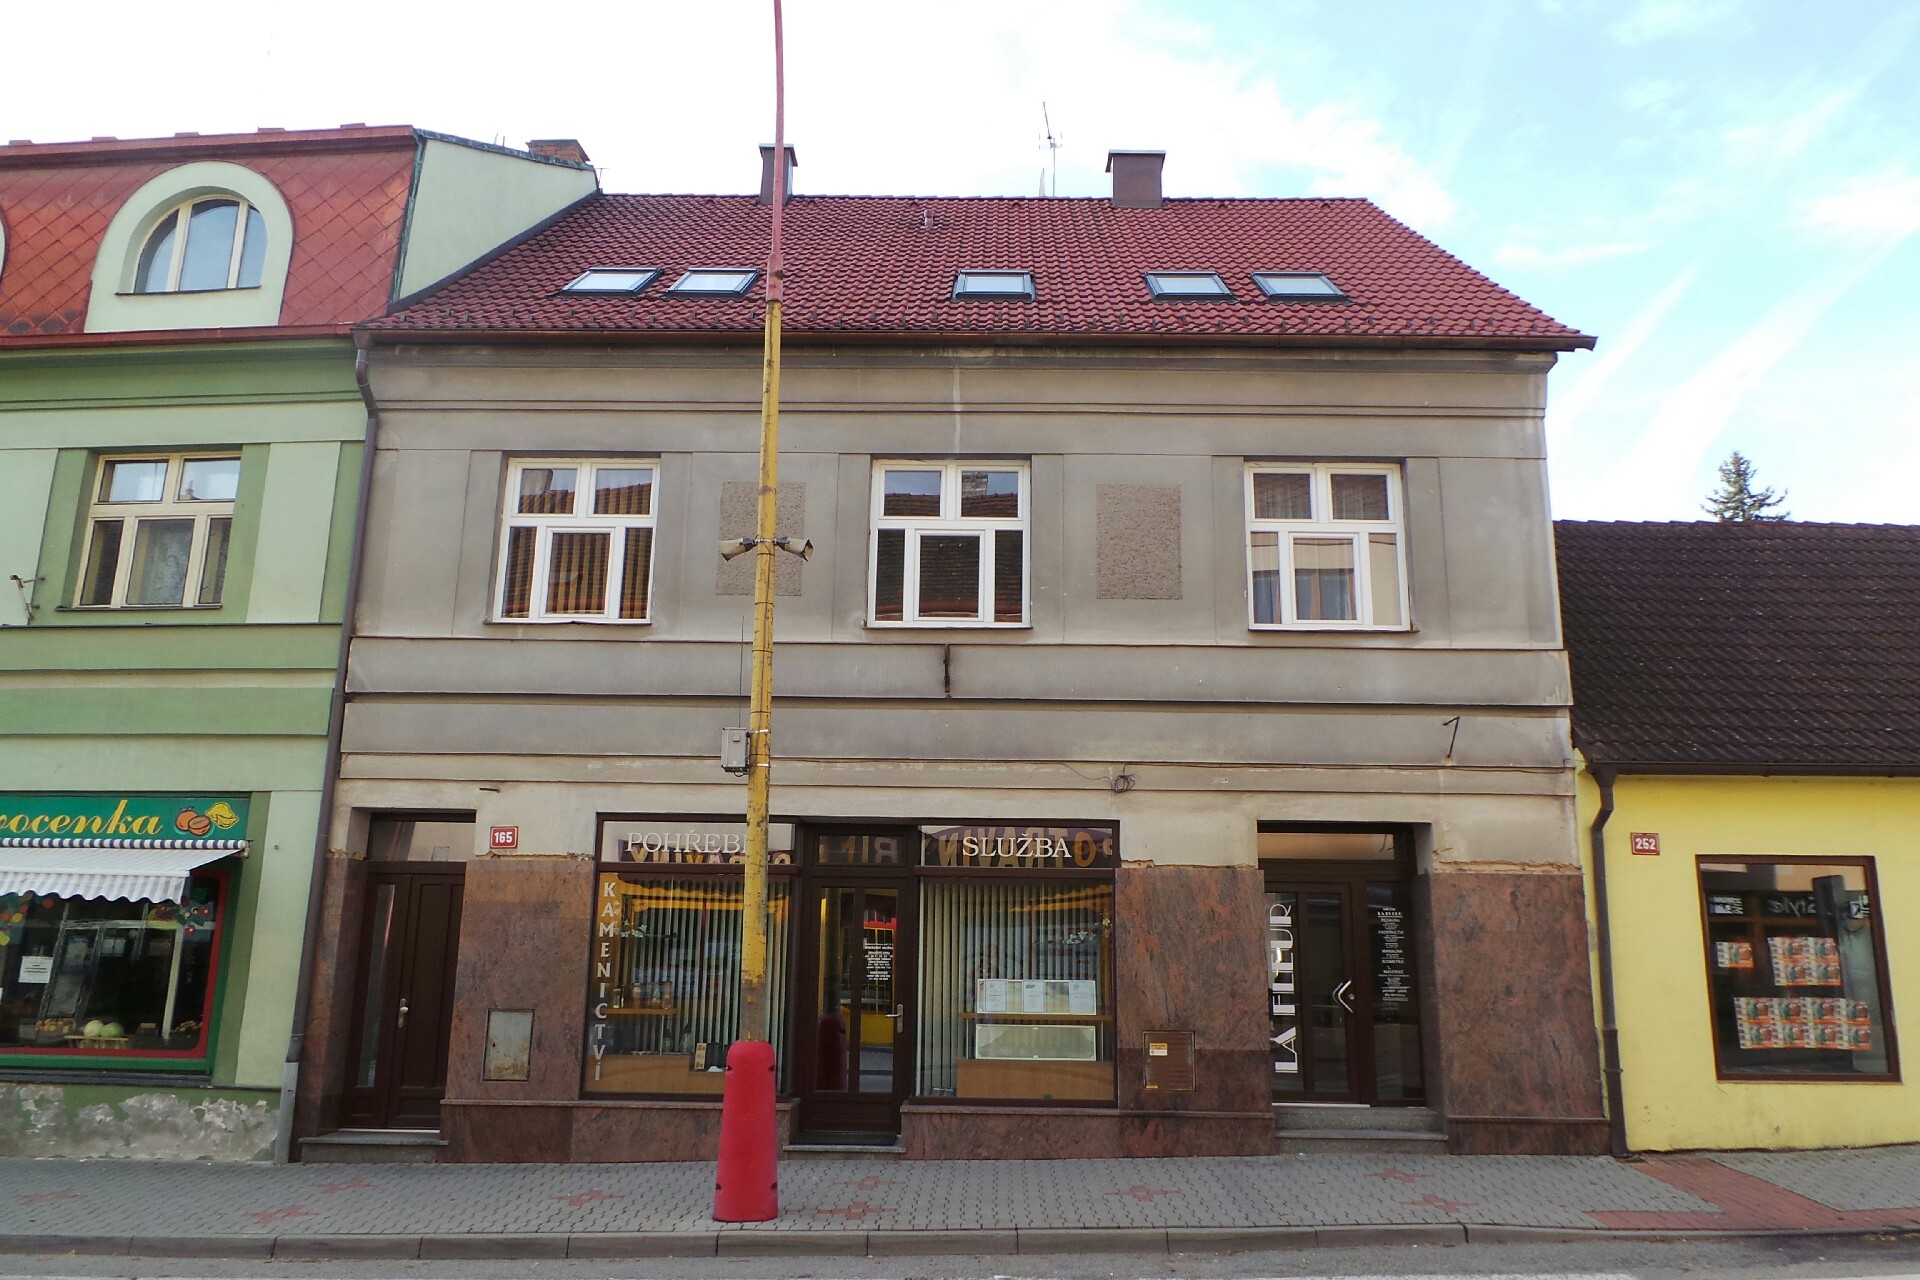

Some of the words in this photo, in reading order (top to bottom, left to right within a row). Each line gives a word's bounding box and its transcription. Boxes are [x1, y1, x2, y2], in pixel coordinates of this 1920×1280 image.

[493, 831, 513, 843] 165
[625, 829, 746, 854] POHŘEB
[962, 832, 1073, 858] SLUŽBA
[1634, 837, 1657, 850] 252
[1269, 903, 1296, 1016] FLEUR
[593, 881, 617, 1082] KAMENICTVÍ
[1269, 1026, 1298, 1074] LA
